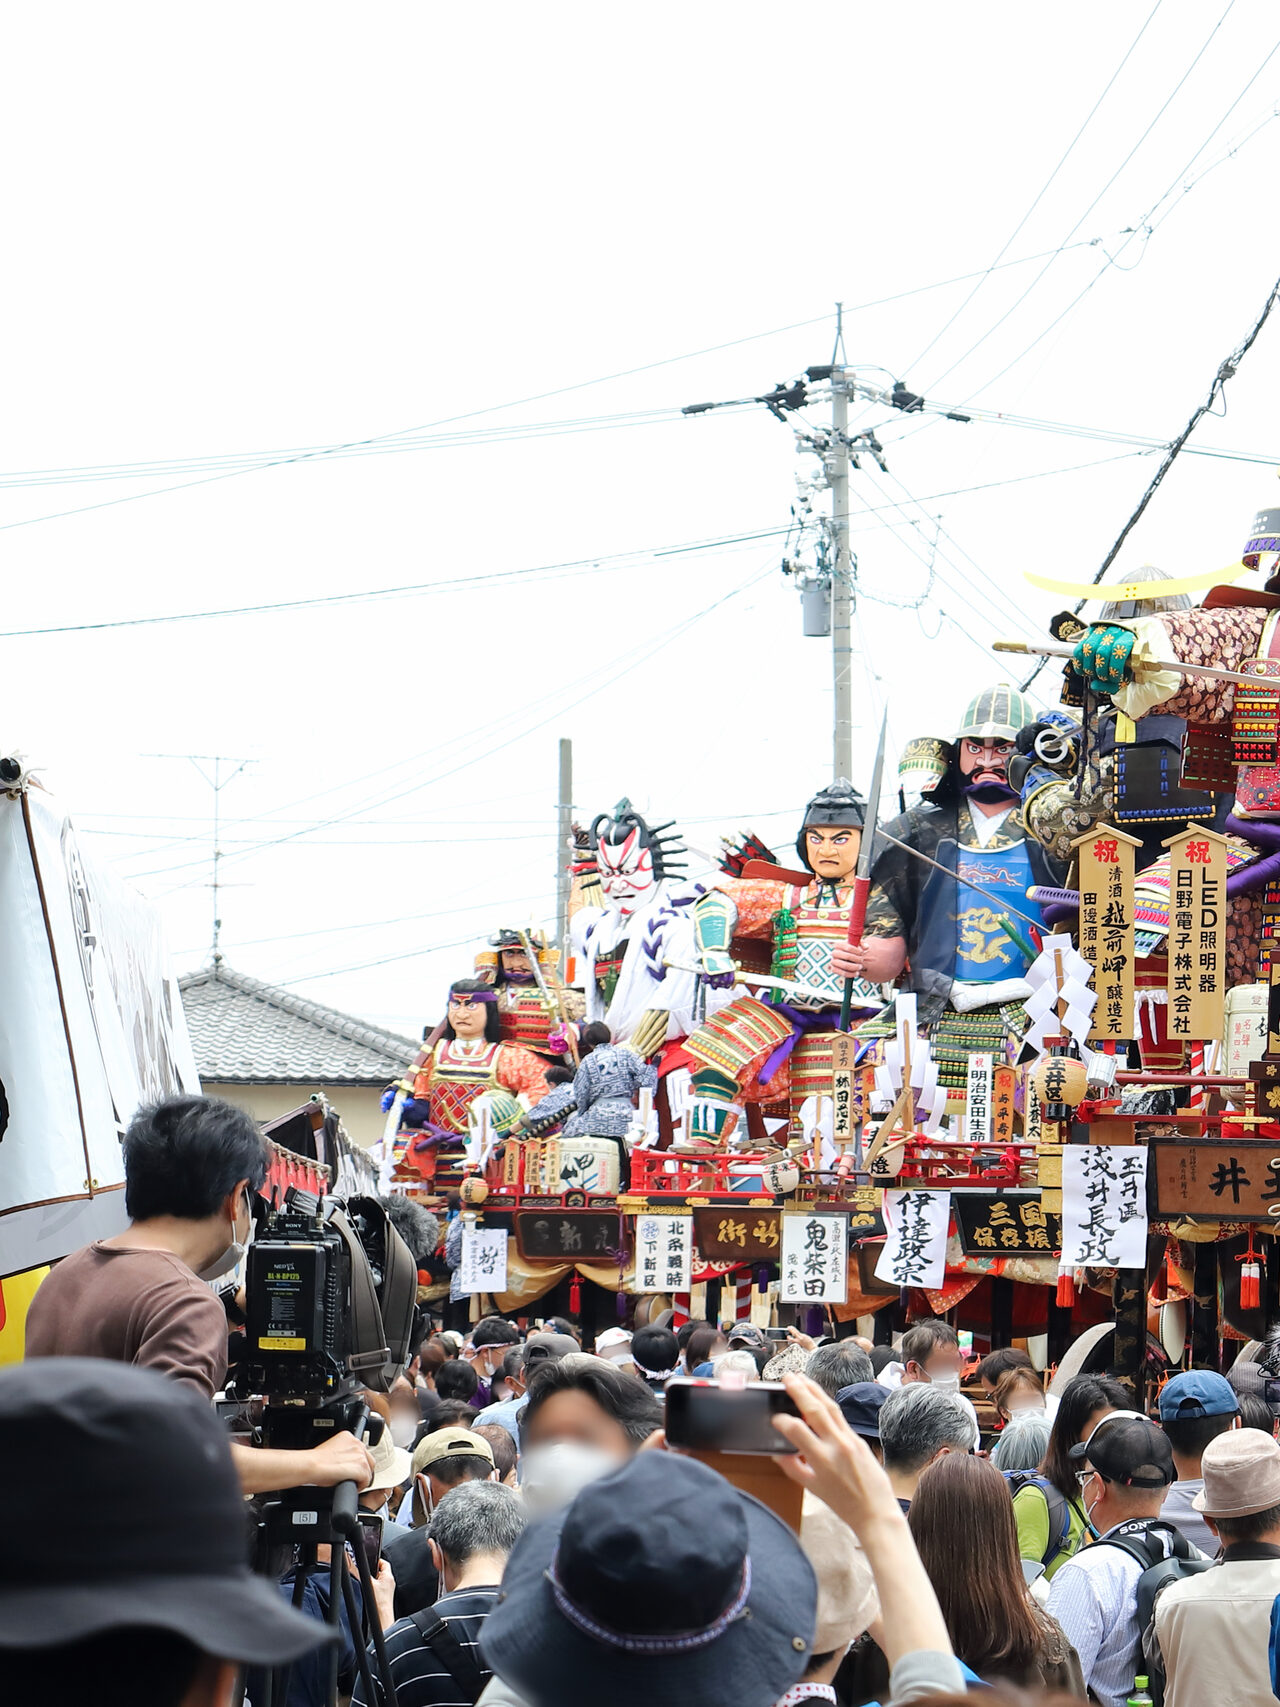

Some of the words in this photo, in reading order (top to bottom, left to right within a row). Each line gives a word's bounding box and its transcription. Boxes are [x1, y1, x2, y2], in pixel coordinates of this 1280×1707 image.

[1094, 840, 1119, 863] 祝
[1185, 841, 1211, 863] 祝
[1173, 870, 1193, 1034] 日野電子株式会社
[1198, 867, 1218, 993] LED照明器
[970, 1071, 987, 1142] 明治安田生命
[998, 1074, 1012, 1088] 祝
[892, 1192, 938, 1285] 伊達政宗
[1076, 1146, 1118, 1266] 浅井長政
[803, 1219, 829, 1298] 鬼柴田
